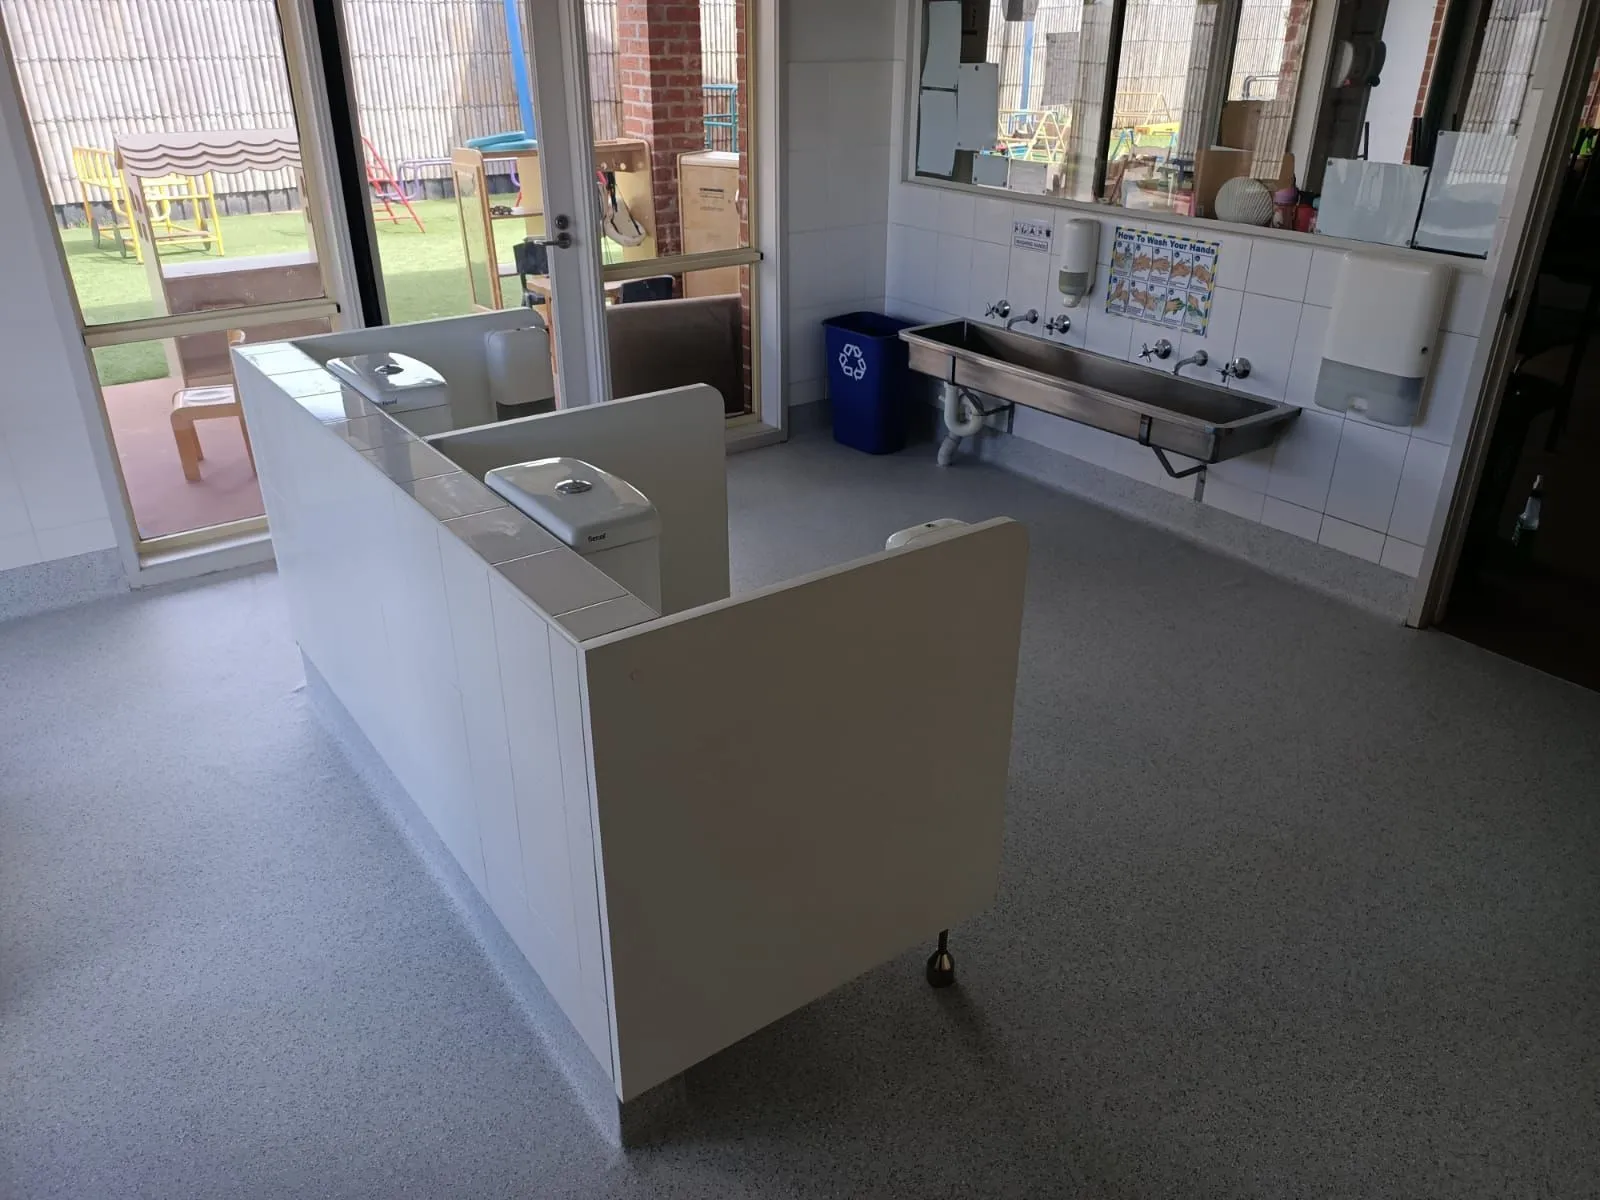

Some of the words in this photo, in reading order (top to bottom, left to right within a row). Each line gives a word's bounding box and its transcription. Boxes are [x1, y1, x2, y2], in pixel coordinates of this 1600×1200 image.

[1118, 231, 1135, 241] How
[1136, 234, 1146, 243] To
[1147, 237, 1168, 247] Wash
[1170, 240, 1187, 250] Your
[1189, 243, 1215, 255] Hands
